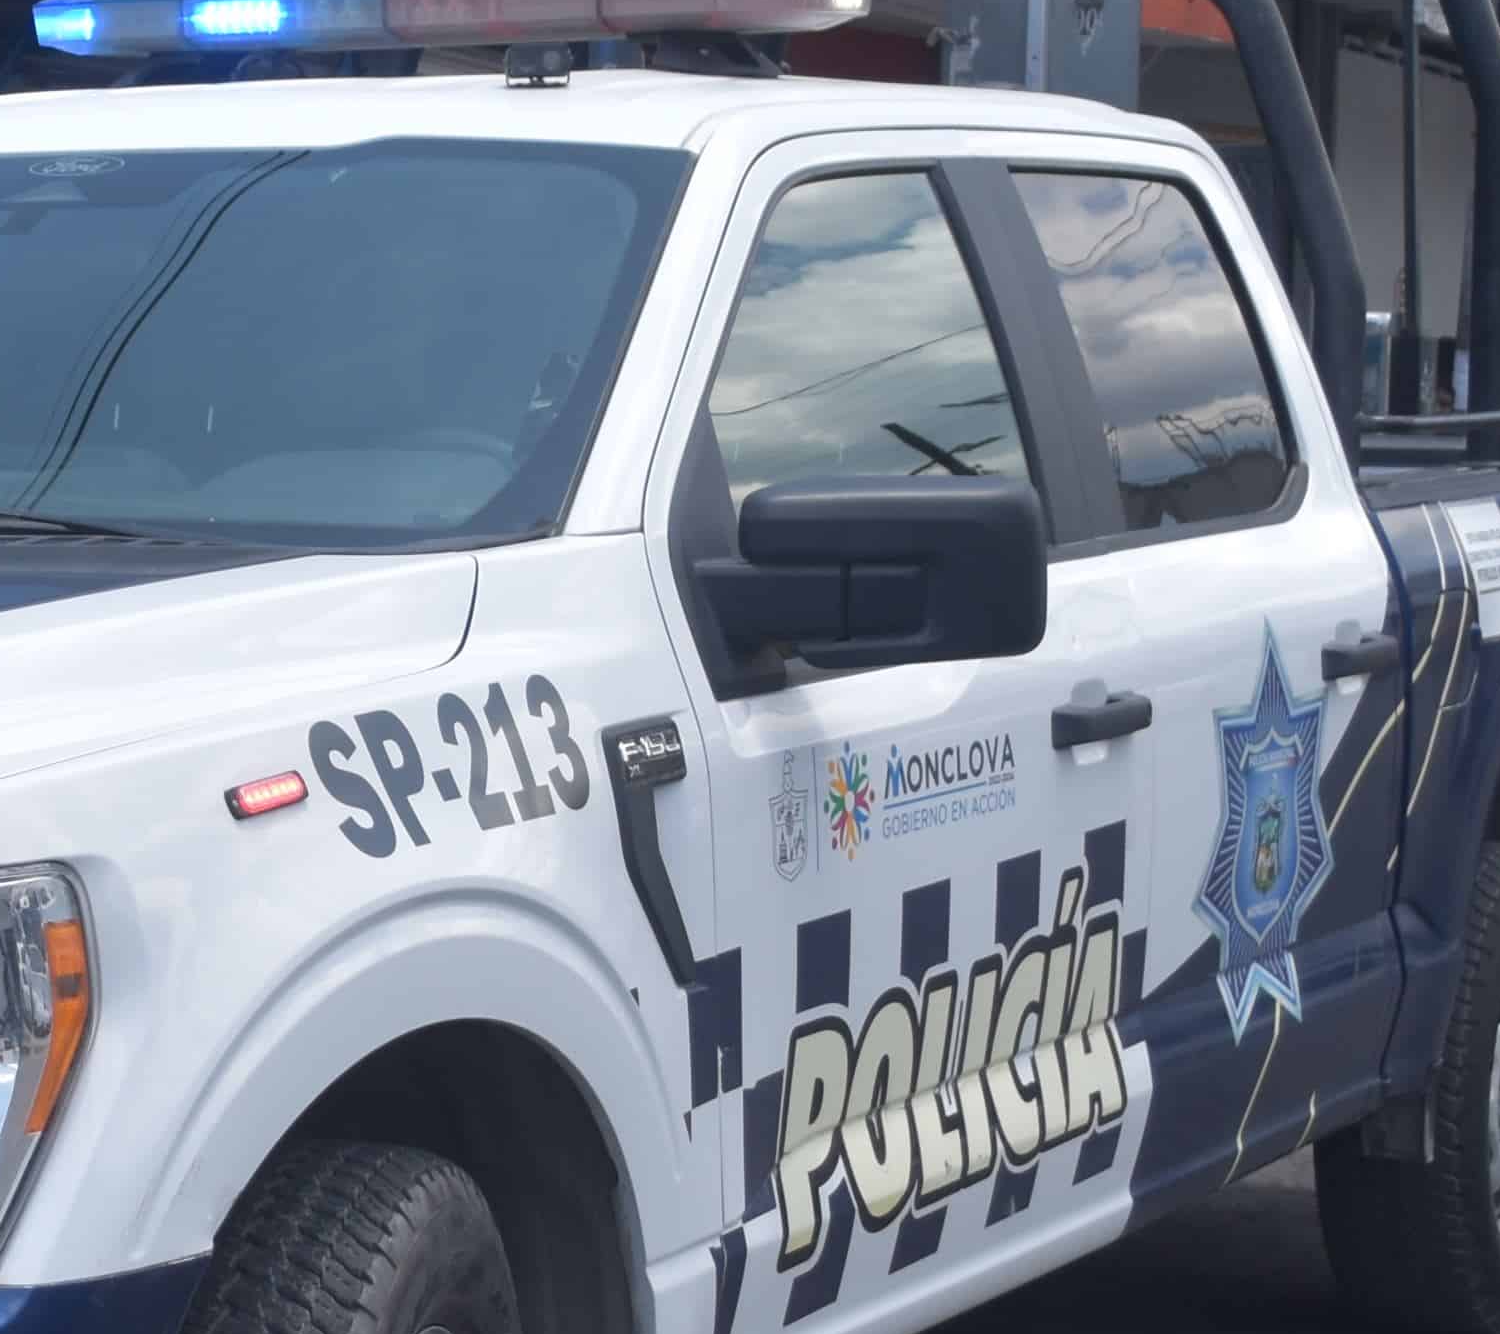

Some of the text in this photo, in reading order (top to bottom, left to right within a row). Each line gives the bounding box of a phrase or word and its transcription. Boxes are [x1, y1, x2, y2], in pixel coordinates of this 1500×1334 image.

[307, 673, 590, 860] SP-213
[882, 785, 1016, 838] GOBIERNO EN ACCIÓN
[884, 733, 1016, 799] MONCLOVA
[777, 868, 1128, 1273] POLICÍA
